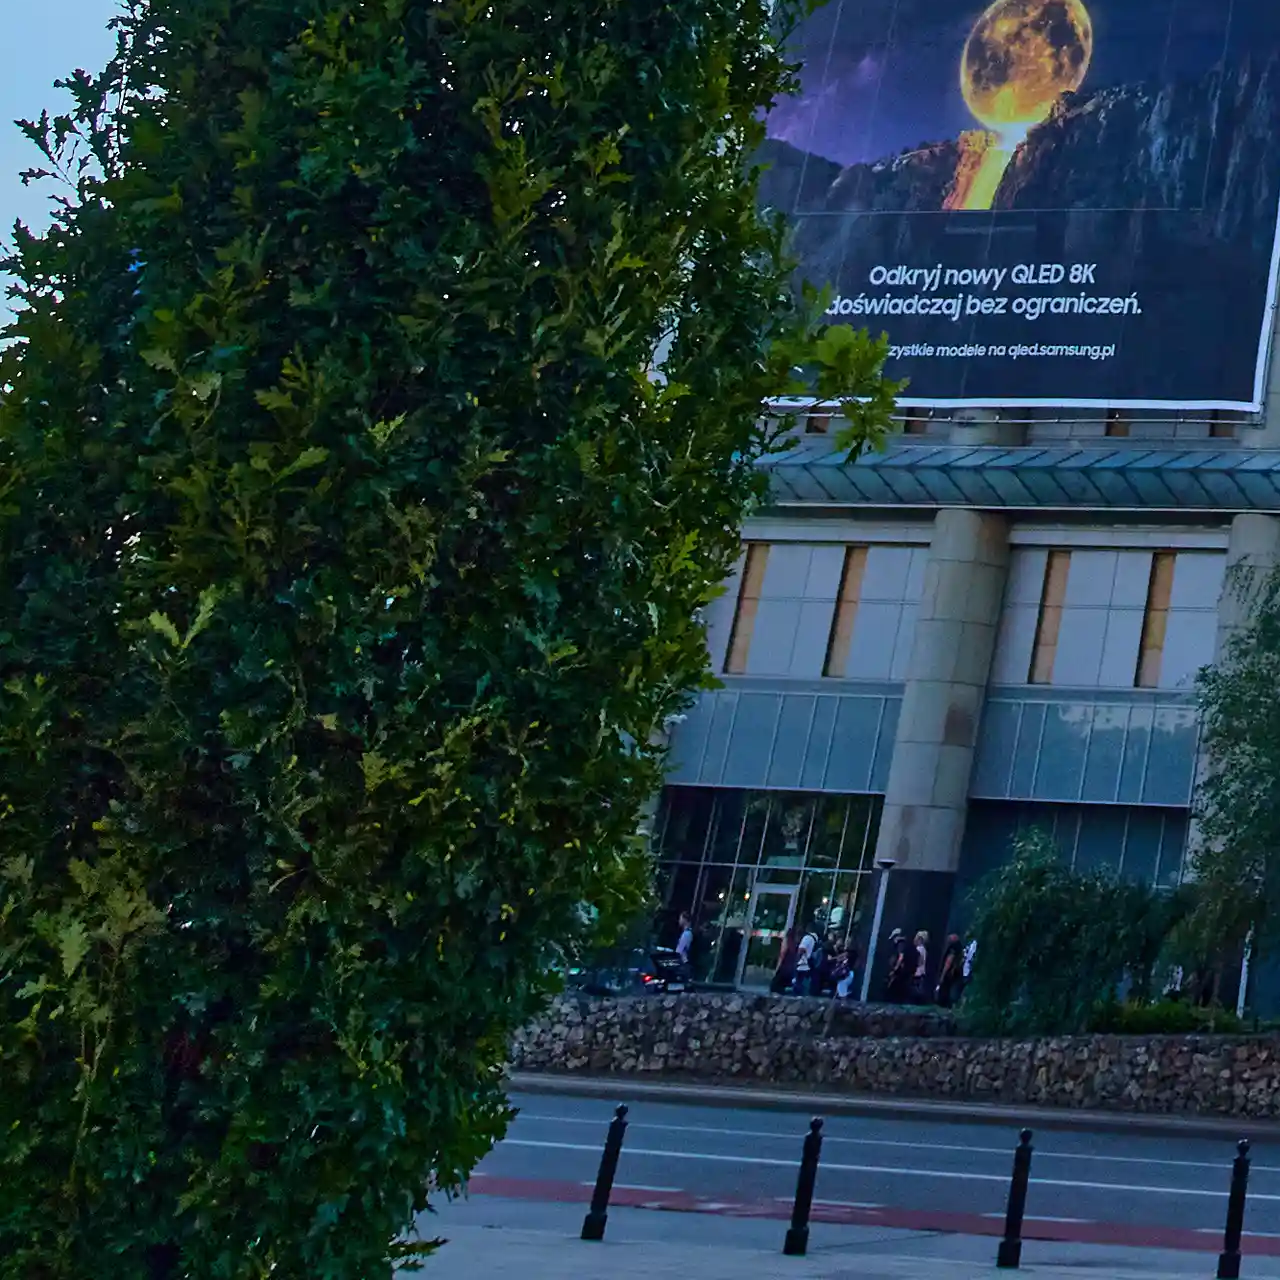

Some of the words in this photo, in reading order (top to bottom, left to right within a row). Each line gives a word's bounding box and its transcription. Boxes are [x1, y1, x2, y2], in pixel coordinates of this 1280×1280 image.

[869, 263, 943, 291] Odkryj
[943, 268, 1007, 291] nowy
[1011, 263, 1065, 284] QLED
[1068, 263, 1097, 284] 8K
[825, 292, 963, 322] doświadczaj
[965, 294, 1008, 315] bez
[1011, 291, 1143, 321] ograniczeń.
[935, 343, 986, 357] modele
[987, 345, 1006, 356] na
[1008, 342, 1116, 360] qled.samsung.pl
